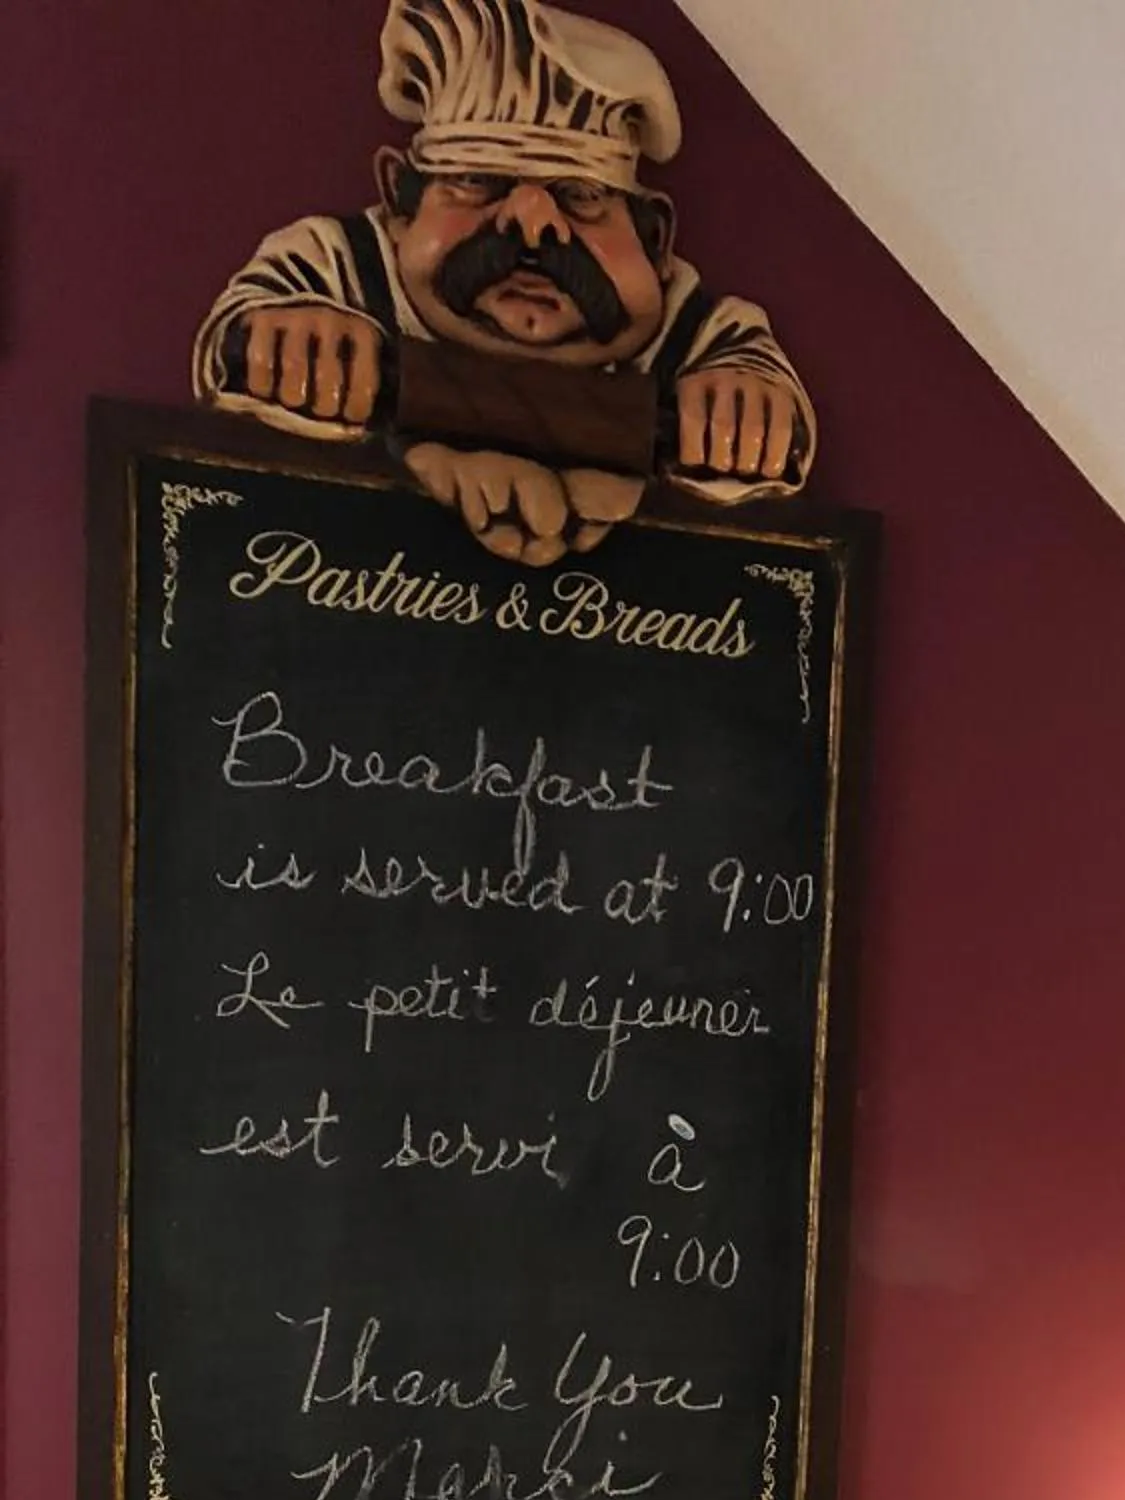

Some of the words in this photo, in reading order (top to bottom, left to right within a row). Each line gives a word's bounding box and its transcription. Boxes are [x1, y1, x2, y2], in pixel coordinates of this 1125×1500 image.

[229, 531, 487, 627] Pastries
[496, 582, 534, 632] &
[540, 571, 757, 659] Breads
[211, 691, 673, 876] Breakfast
[216, 843, 317, 892] is
[341, 847, 584, 915] served
[605, 853, 671, 924] at
[708, 857, 814, 932] 9:00
[217, 951, 325, 1029] Le
[348, 963, 498, 1053] petit
[200, 1088, 340, 1169] est
[381, 1114, 570, 1189] servi
[646, 1113, 706, 1193] à
[617, 1214, 741, 1289] 9:00
[275, 1306, 528, 1413] Thank
[540, 1331, 724, 1480] You
